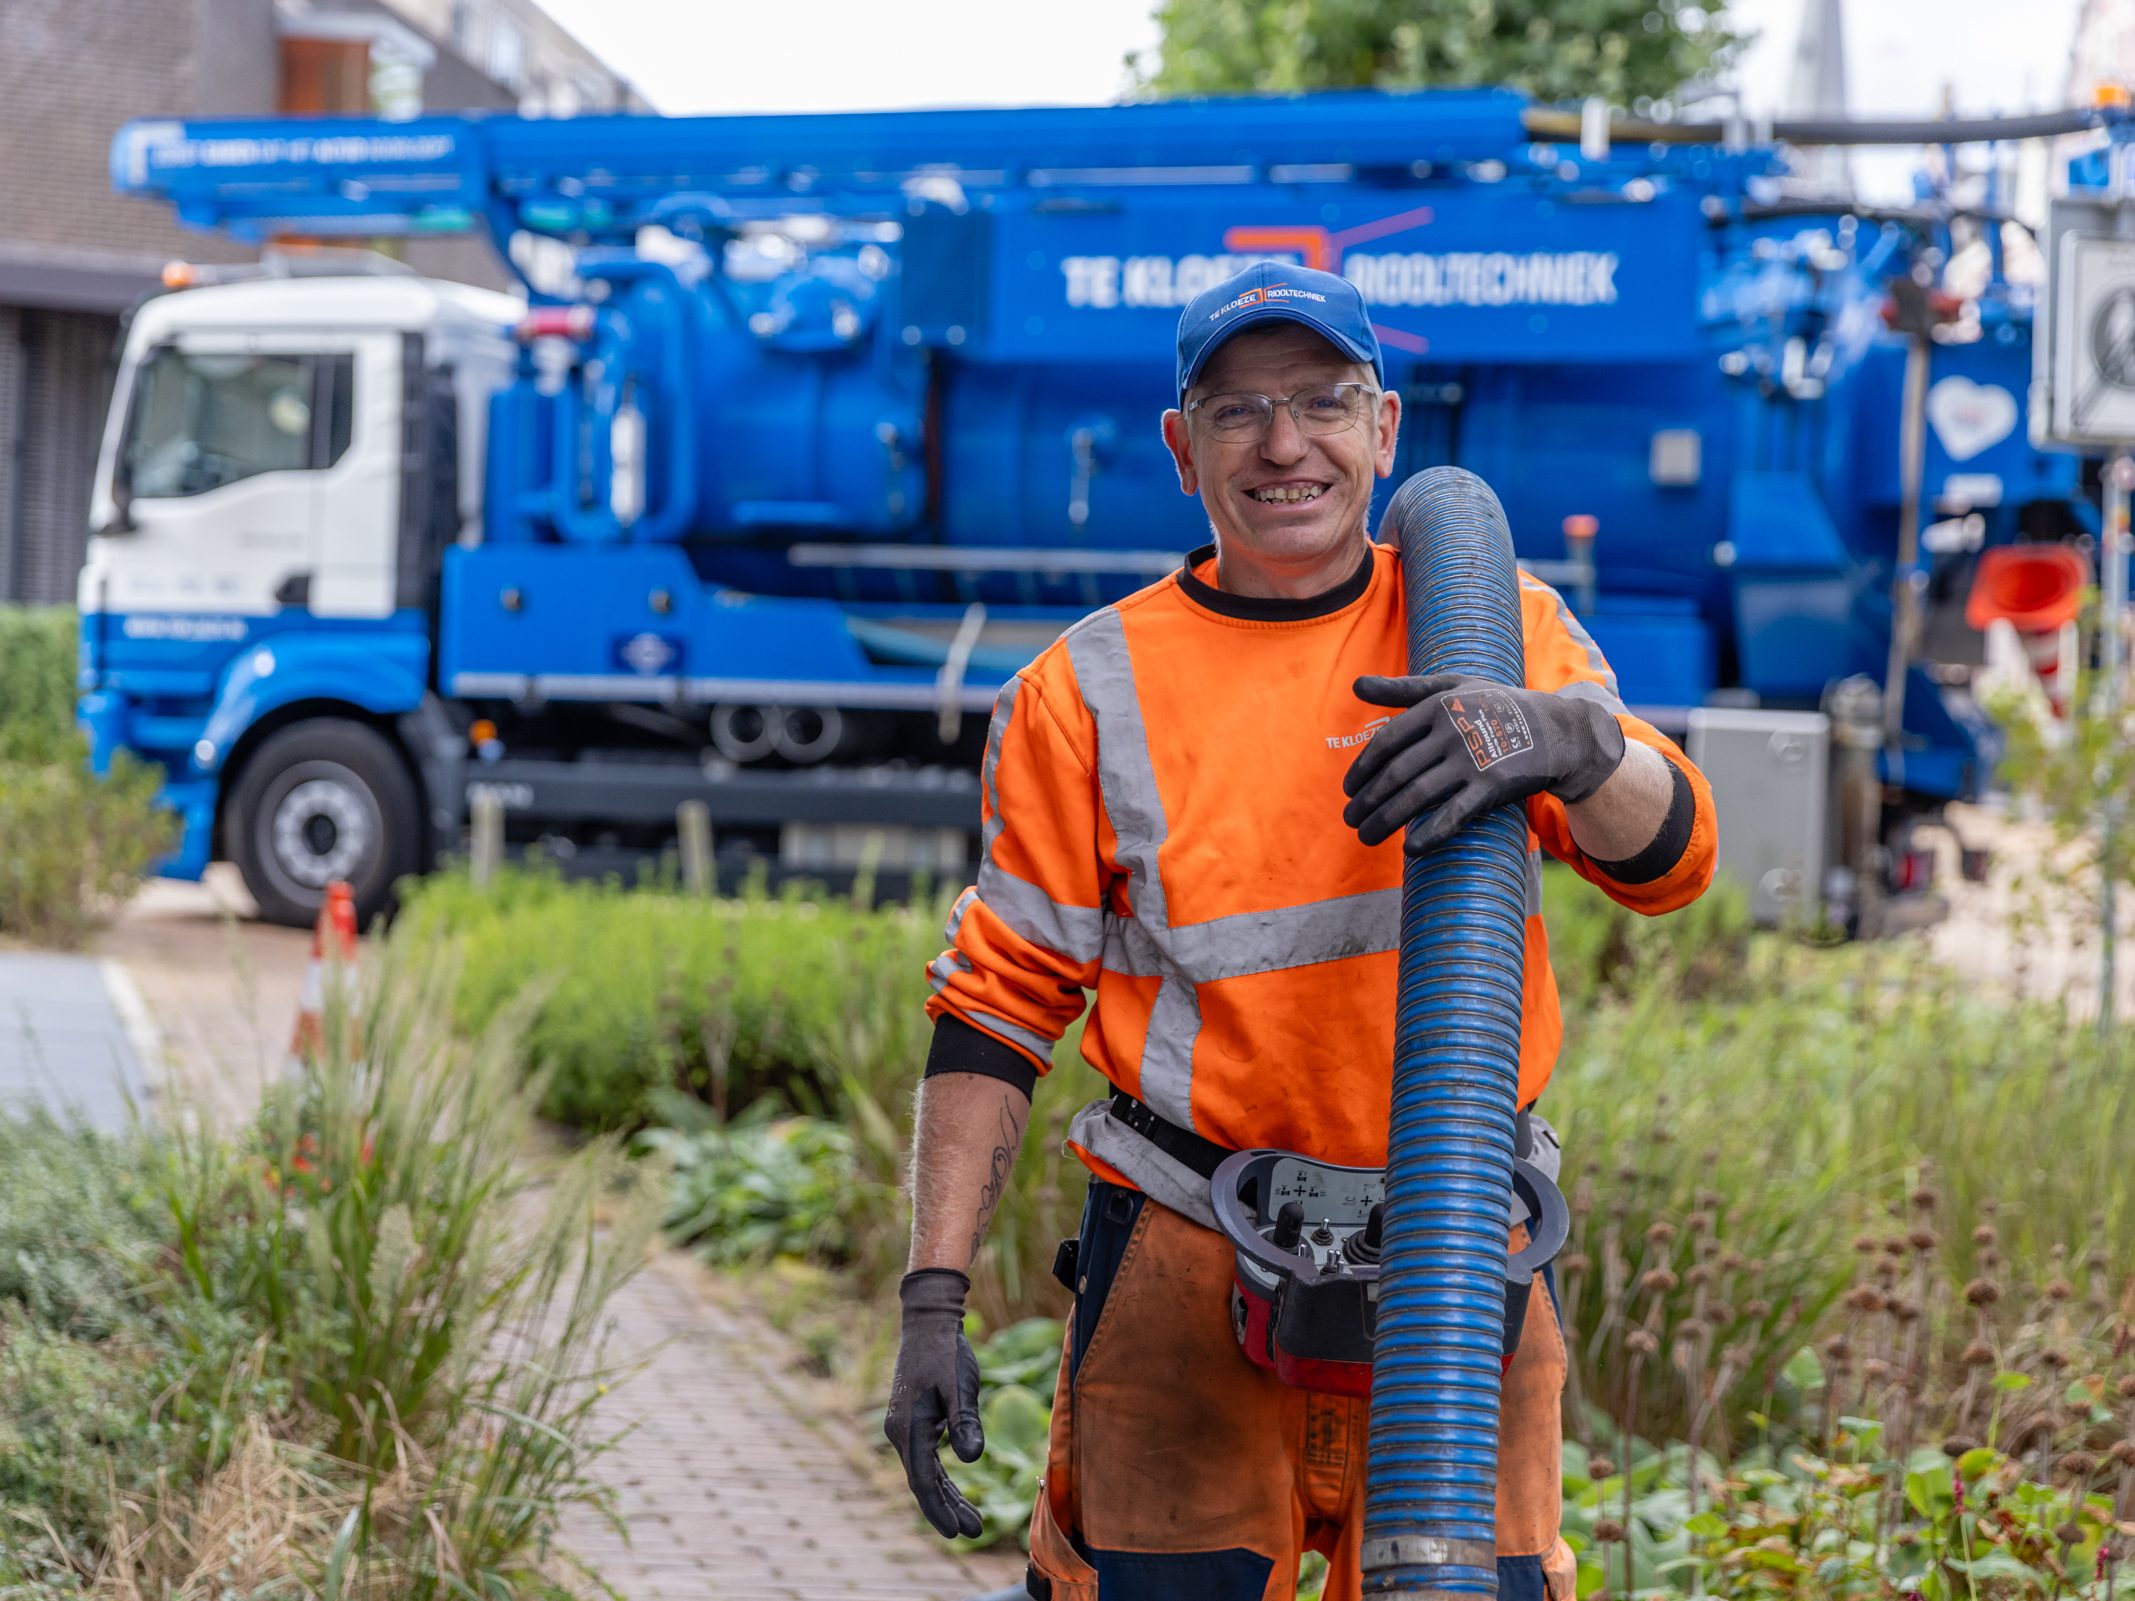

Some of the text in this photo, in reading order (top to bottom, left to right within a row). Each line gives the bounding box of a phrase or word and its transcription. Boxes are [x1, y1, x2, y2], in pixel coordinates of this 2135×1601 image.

[1062, 254, 1120, 308] TE
[1208, 288, 1327, 321] TE KLOEZE RIOOLTECHNIEK
[1326, 725, 1382, 749] TE KLOEZ
[1457, 717, 1491, 768] PSP
[1474, 719, 1498, 758] Allround
